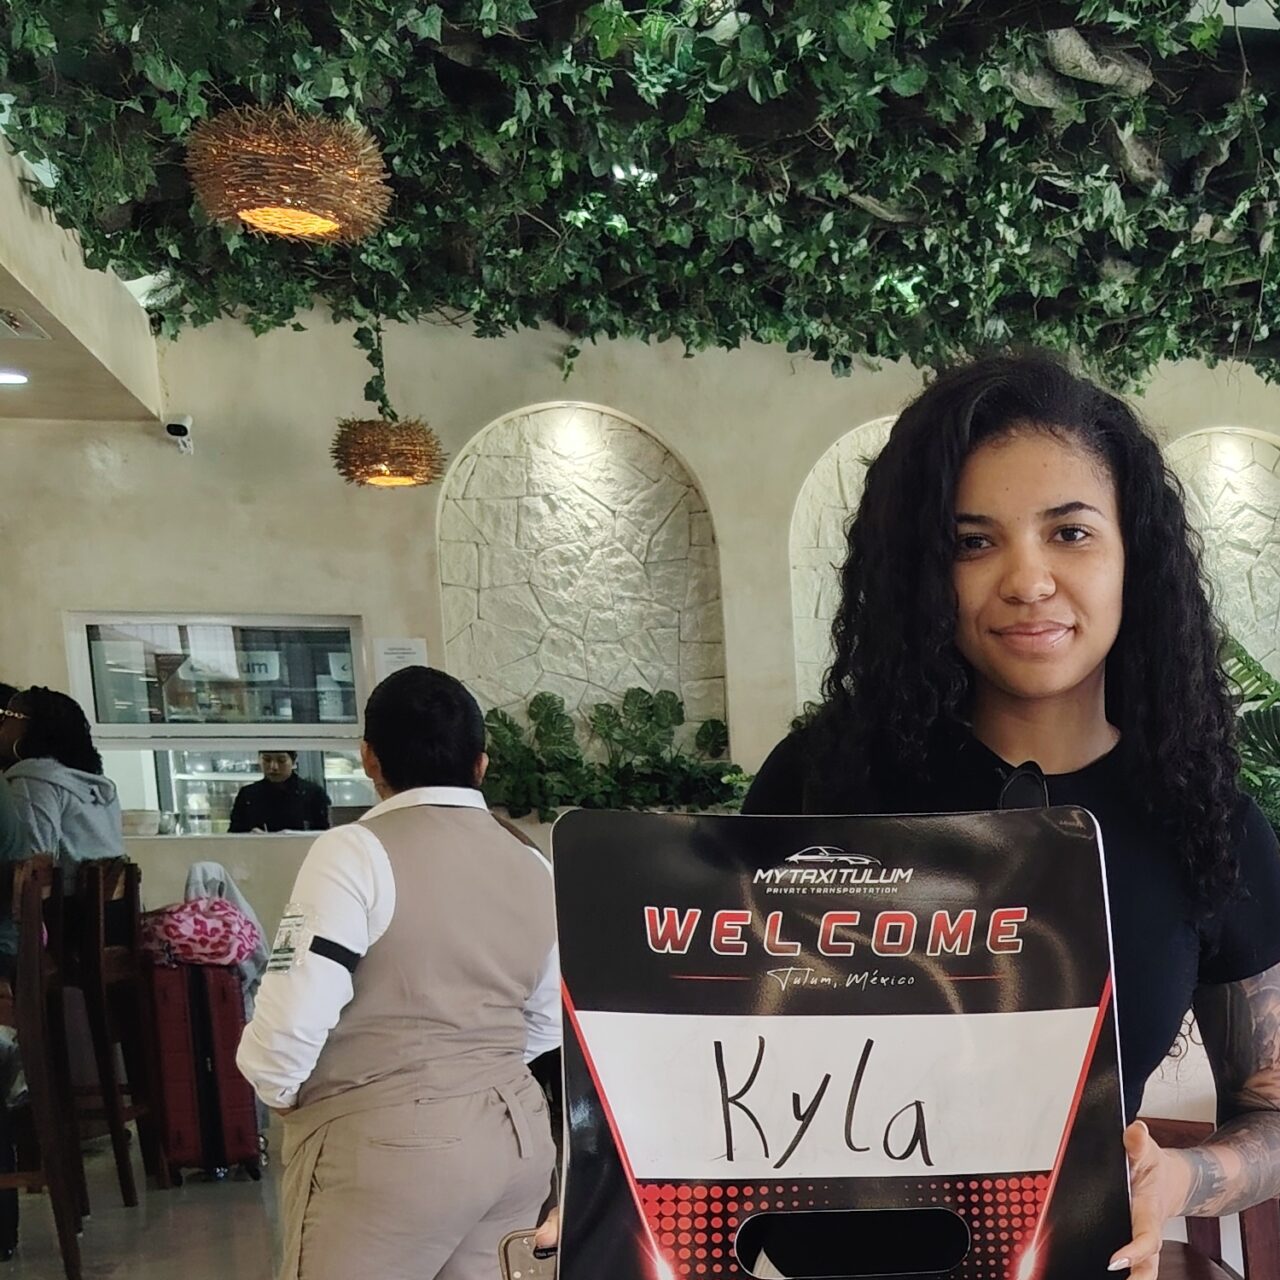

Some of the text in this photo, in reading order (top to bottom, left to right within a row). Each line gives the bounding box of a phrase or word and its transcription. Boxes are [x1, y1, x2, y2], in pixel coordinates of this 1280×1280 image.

[753, 868, 914, 885] MYTAXITULUM
[643, 906, 1028, 957] WELCOME
[845, 969, 915, 991] México
[713, 1035, 935, 1169] Kyla
